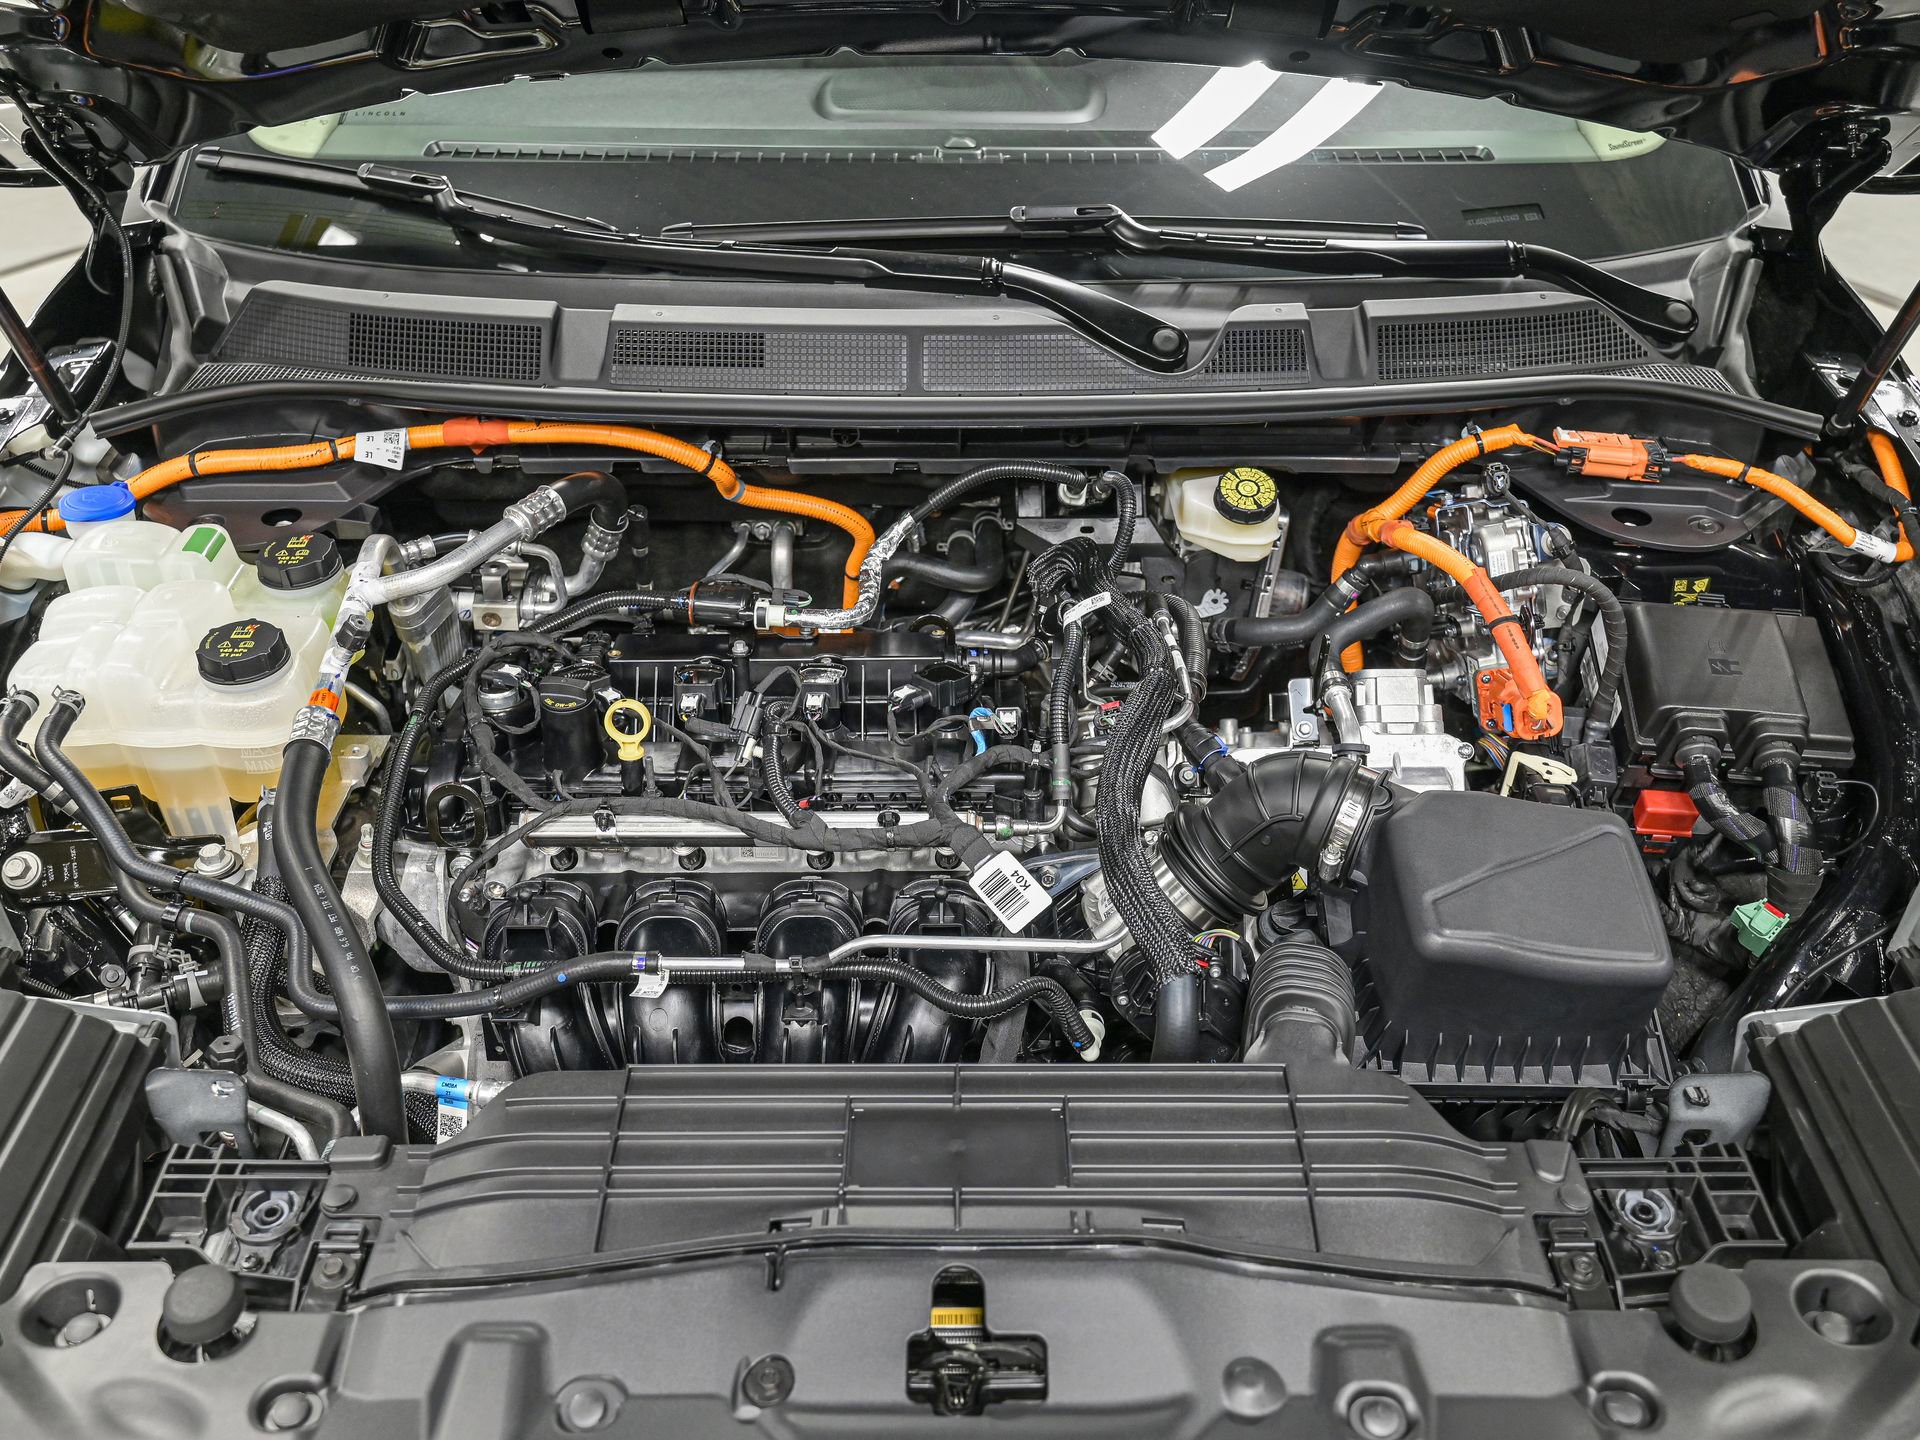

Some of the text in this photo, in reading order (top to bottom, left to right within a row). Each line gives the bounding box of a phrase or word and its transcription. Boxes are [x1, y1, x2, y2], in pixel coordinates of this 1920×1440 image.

[1011, 870, 1031, 891] K04
[328, 914, 338, 923] PET
[346, 951, 355, 960] PA
